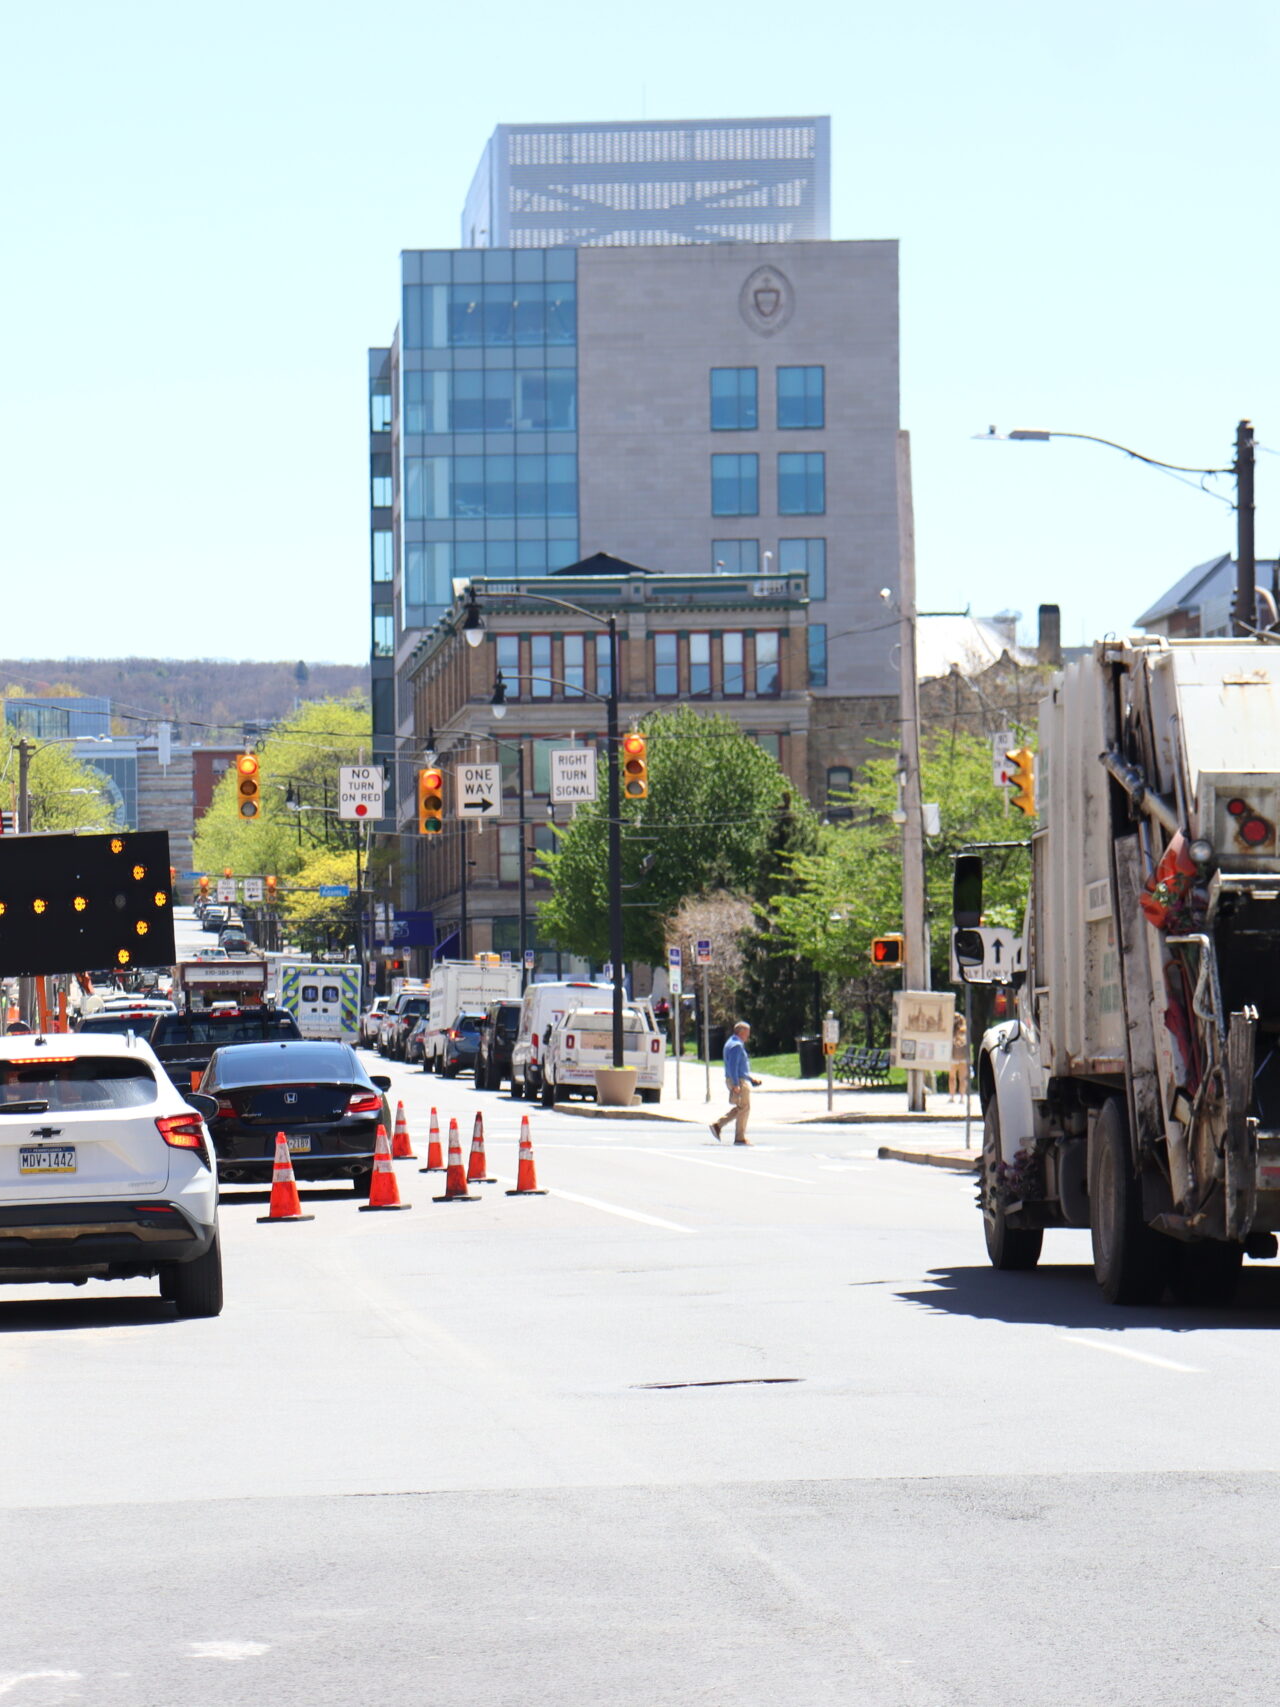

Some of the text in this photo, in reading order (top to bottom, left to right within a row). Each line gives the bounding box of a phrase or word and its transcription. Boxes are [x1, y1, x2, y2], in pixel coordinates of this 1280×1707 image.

[558, 755, 587, 766] RIGHT
[351, 770, 370, 780] NO
[465, 770, 493, 781] ONE
[561, 770, 587, 780] TURN
[348, 782, 374, 791] TURN
[465, 784, 494, 795] WAY
[556, 786, 592, 796] SIGNAL
[341, 793, 381, 802] ON RED
